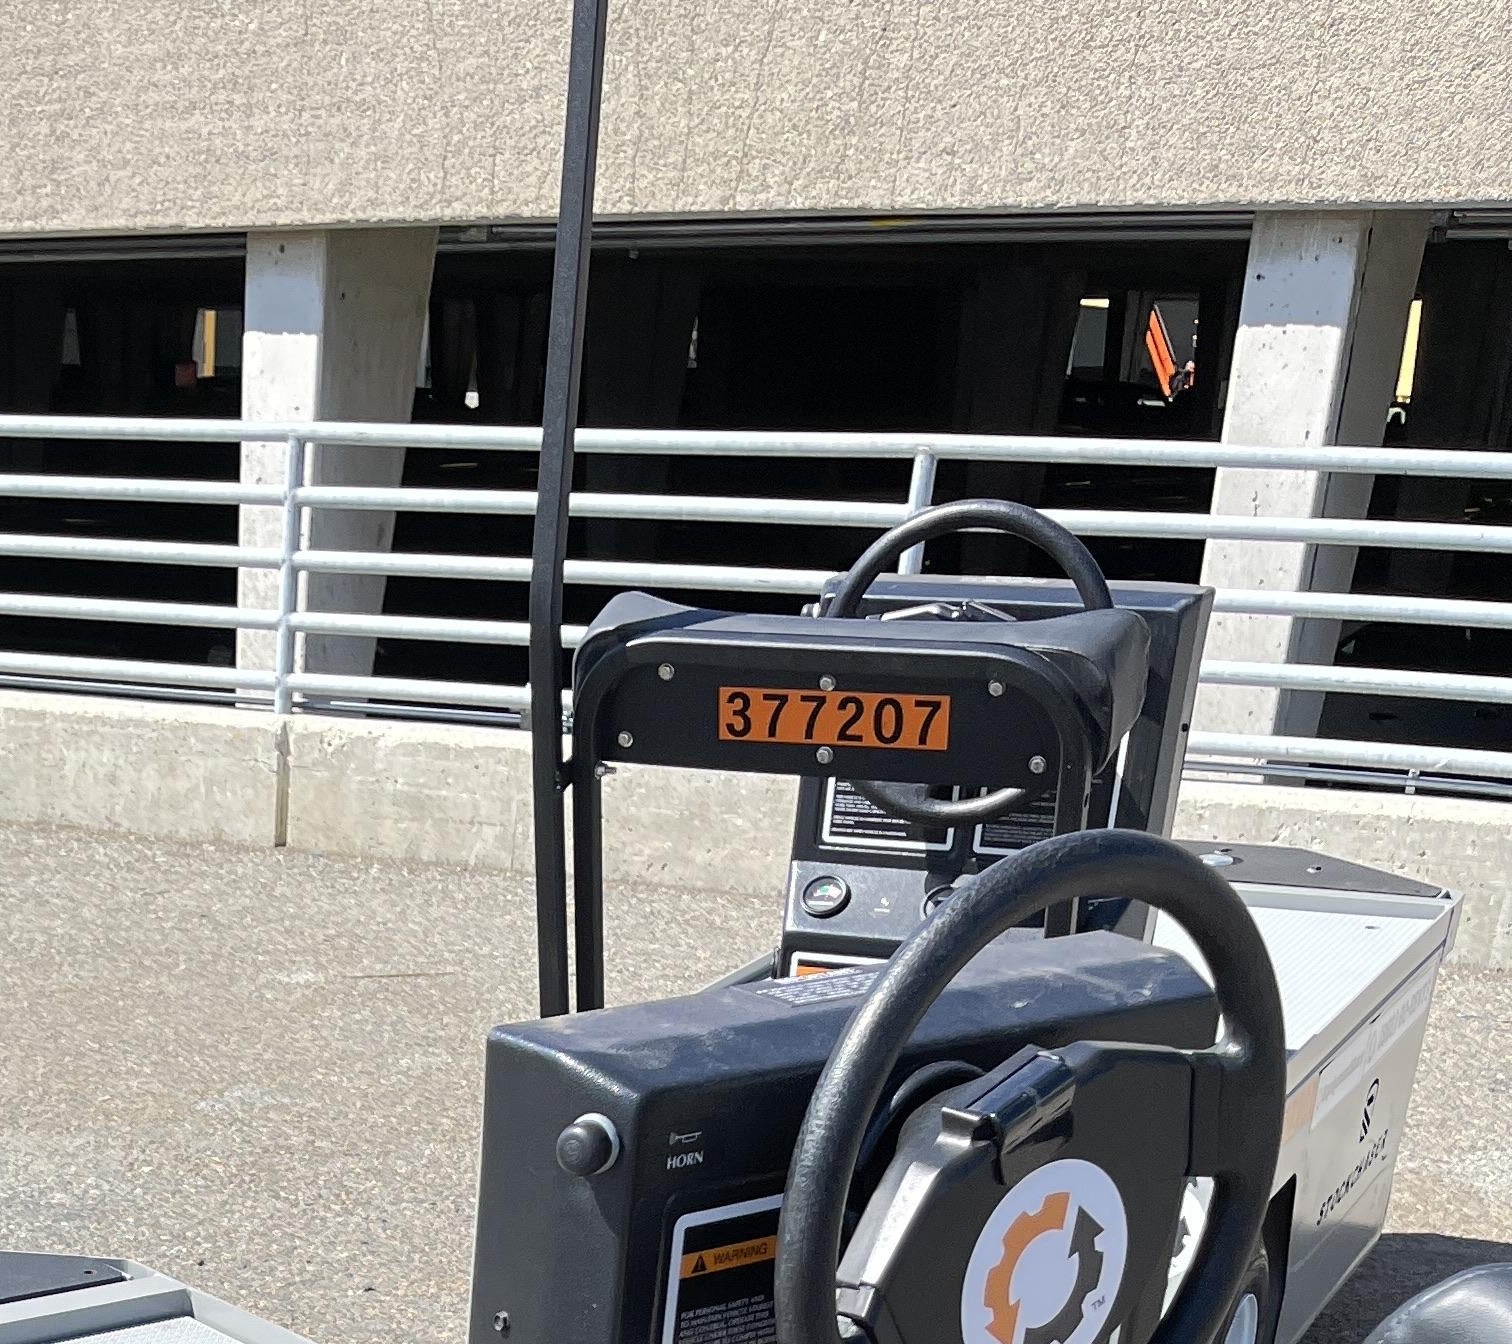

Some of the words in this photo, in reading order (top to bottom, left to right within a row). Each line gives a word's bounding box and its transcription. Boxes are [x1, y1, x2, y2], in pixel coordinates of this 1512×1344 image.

[724, 690, 943, 747] 377207
[666, 1150, 704, 1170] HORN
[713, 1242, 768, 1265] WARNING
